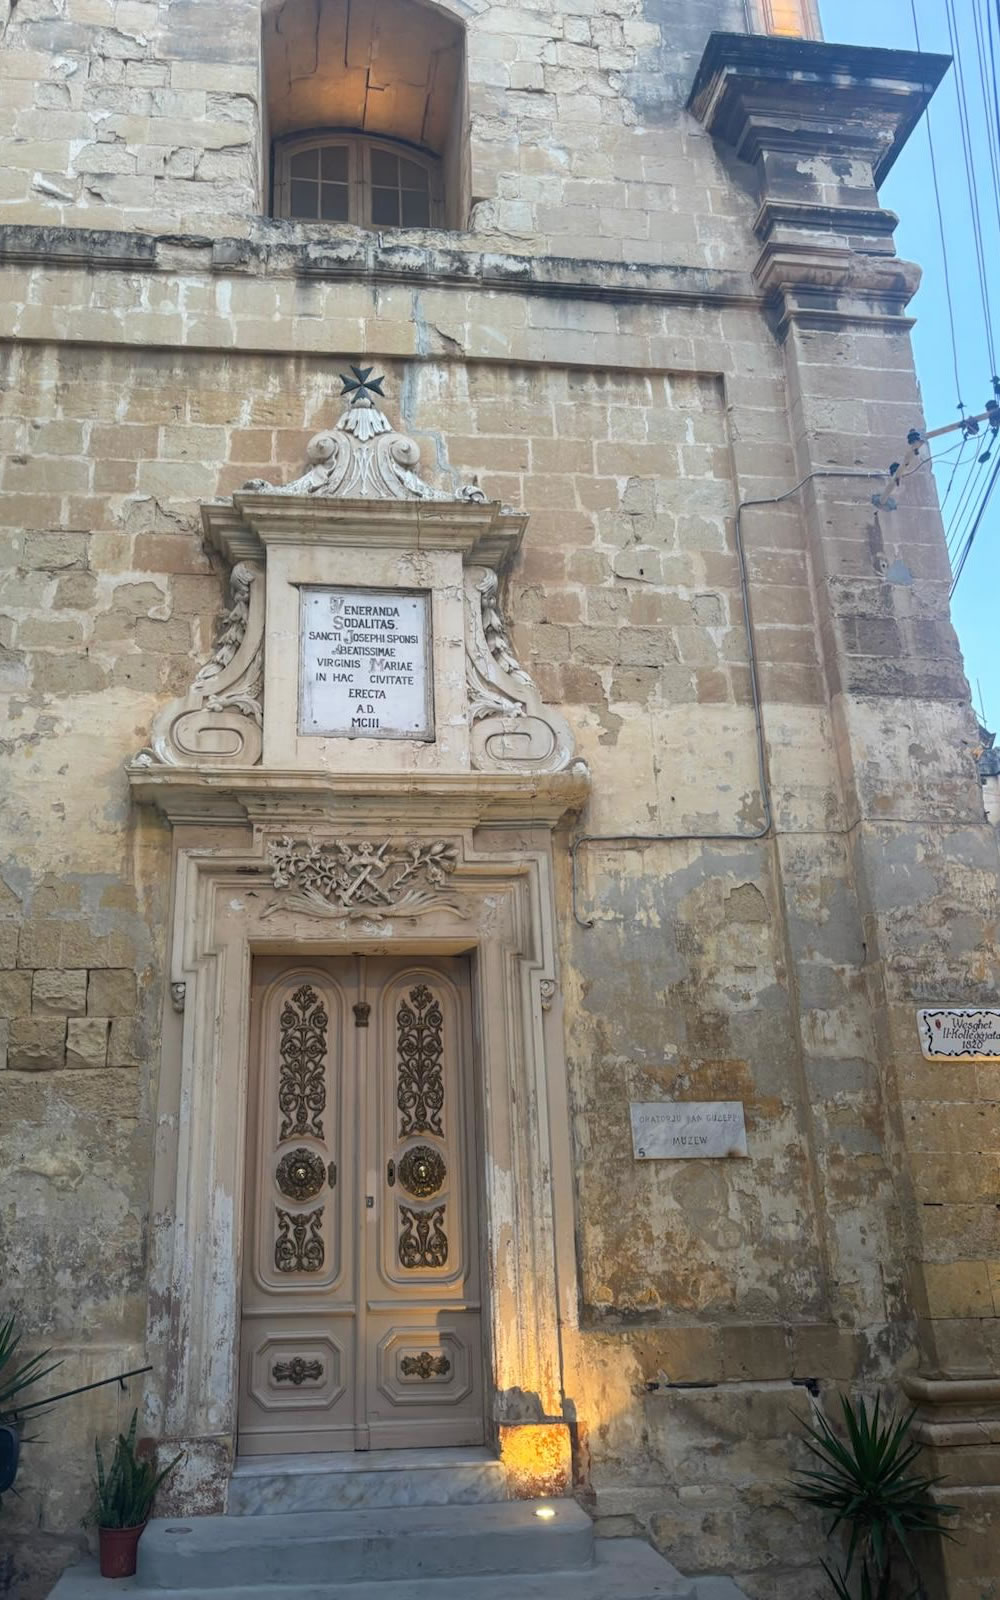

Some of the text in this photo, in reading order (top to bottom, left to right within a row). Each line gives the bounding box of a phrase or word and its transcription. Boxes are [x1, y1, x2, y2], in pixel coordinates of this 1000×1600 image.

[330, 596, 400, 616] VENERANDA
[309, 629, 418, 645] SANCTI JOSEPHI SPONSI
[317, 658, 413, 673] VIRGINIS MARIAE
[315, 672, 415, 685] IN HAC CIVITATE
[348, 688, 386, 699] ERECTA
[356, 704, 376, 714] A.D.
[351, 717, 380, 729] MCIII
[962, 1040, 983, 1050] 1820
[638, 1147, 646, 1158] 5
